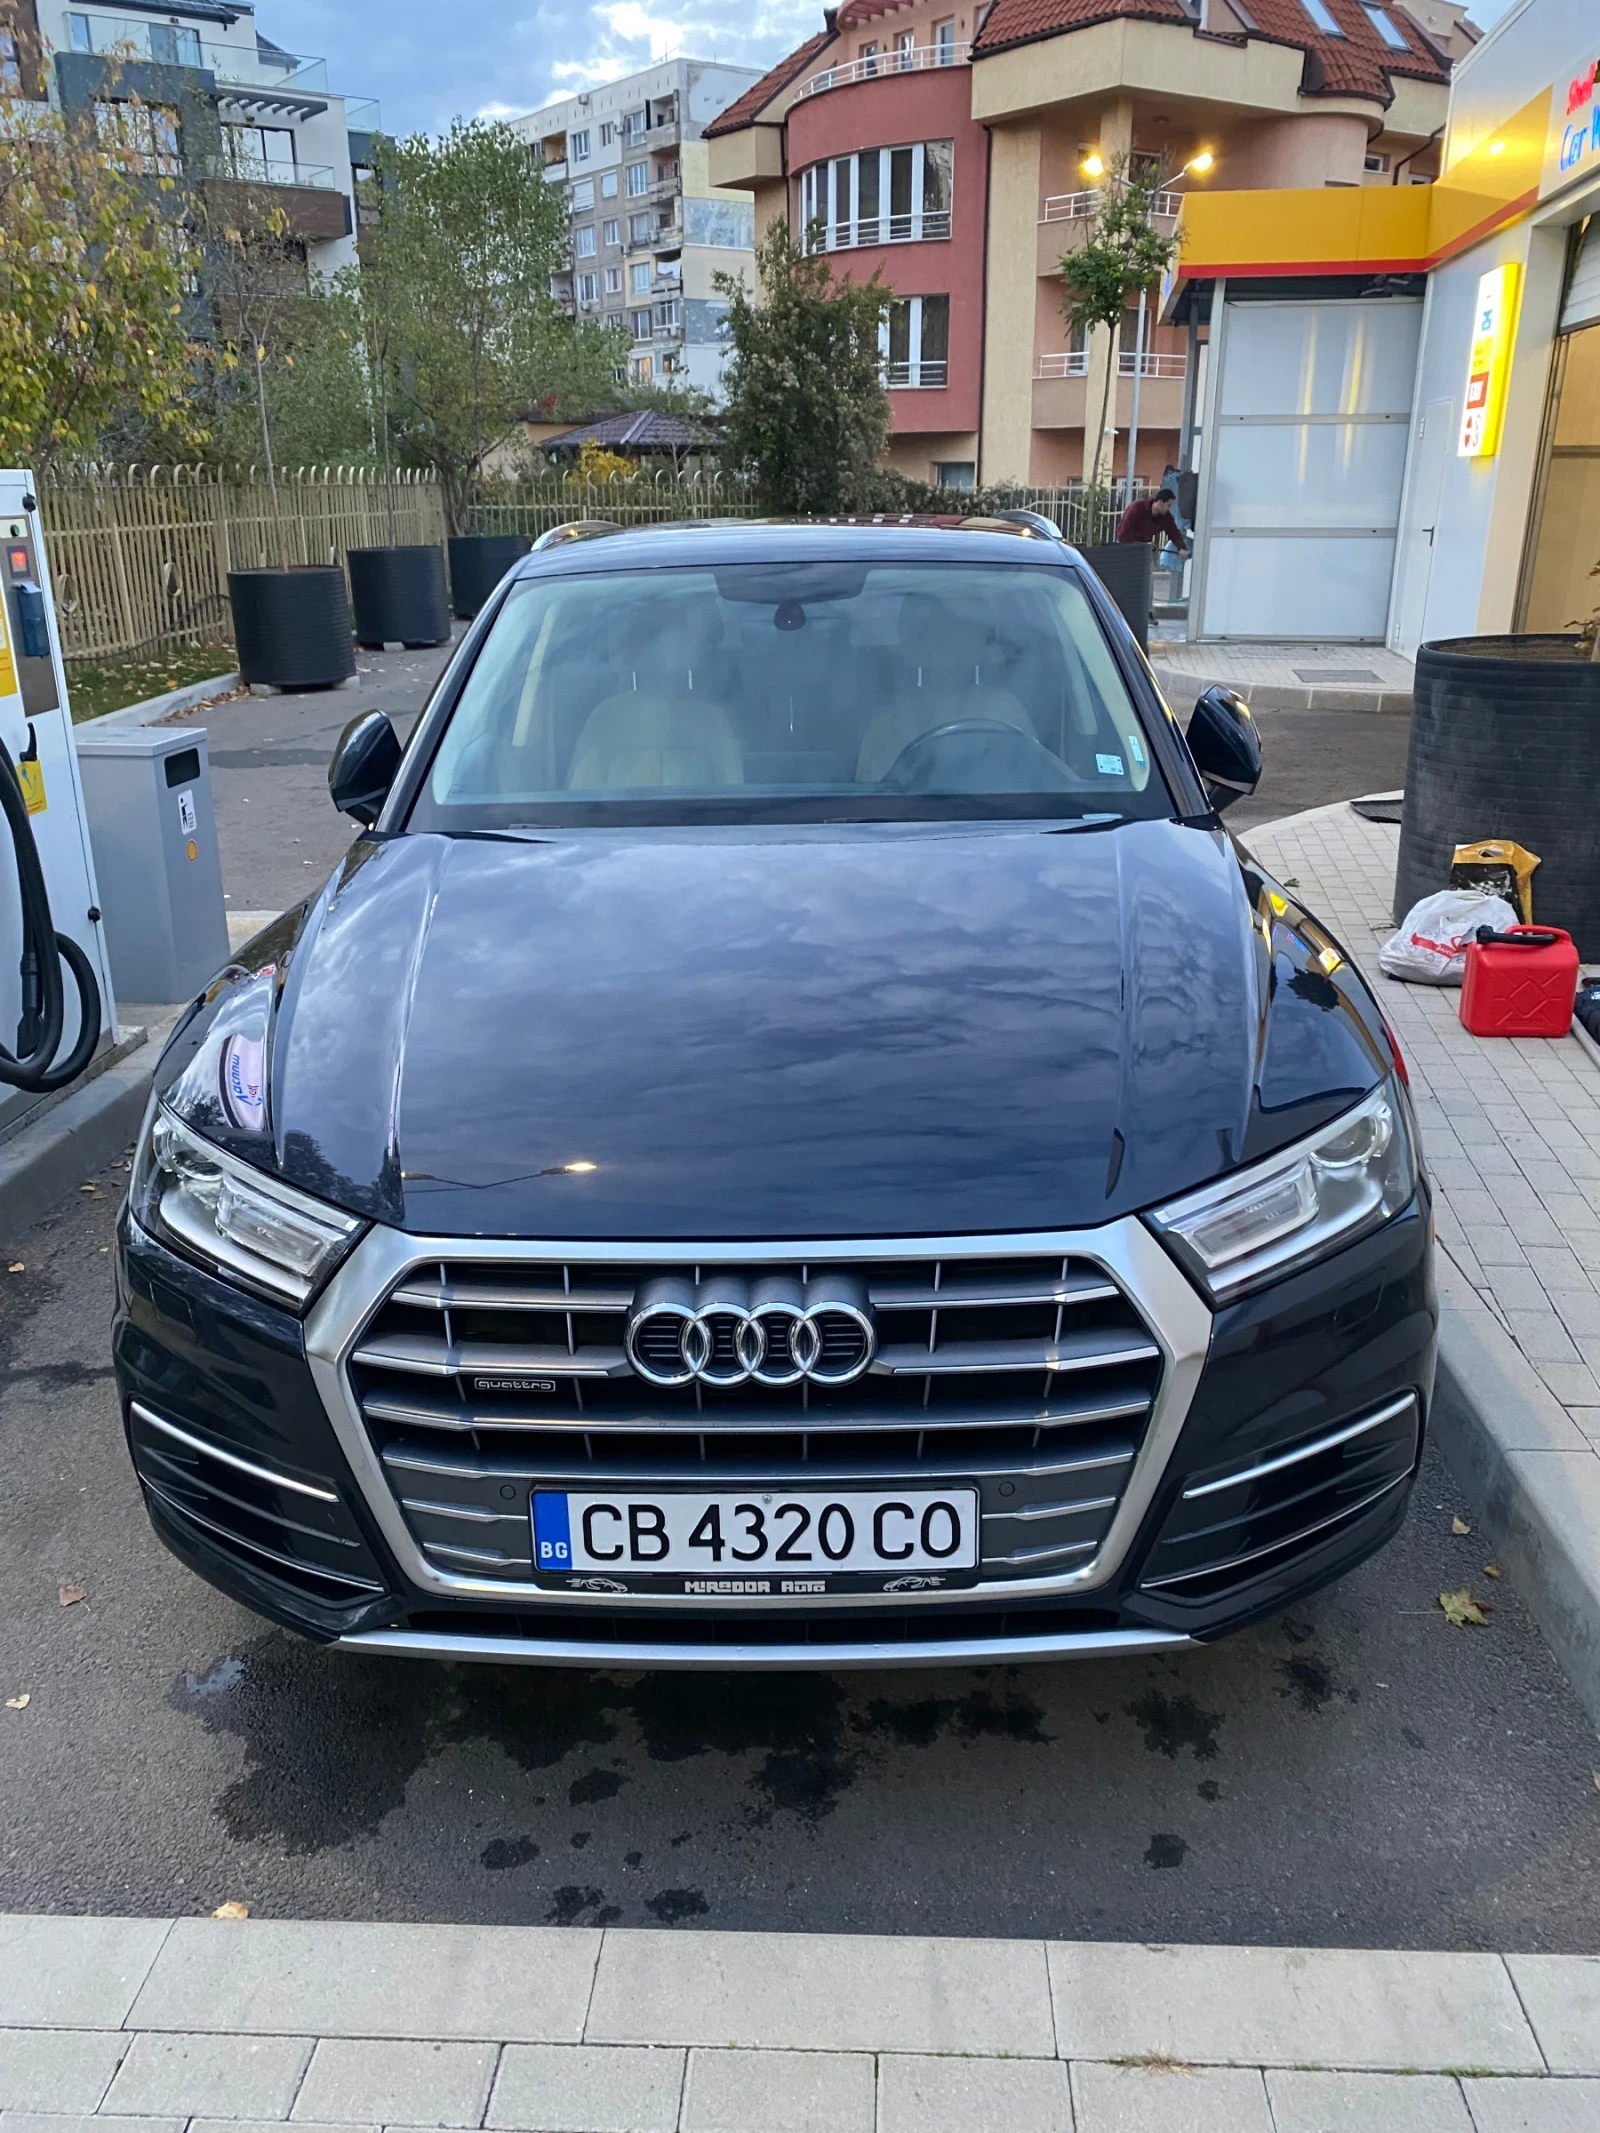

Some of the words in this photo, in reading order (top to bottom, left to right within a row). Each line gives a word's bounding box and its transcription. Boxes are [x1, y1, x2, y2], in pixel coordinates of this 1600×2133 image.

[478, 1380, 552, 1390] quattro
[582, 1503, 670, 1562] CB
[688, 1503, 855, 1562] 4320
[872, 1501, 961, 1560] CO
[540, 1542, 569, 1560] BG
